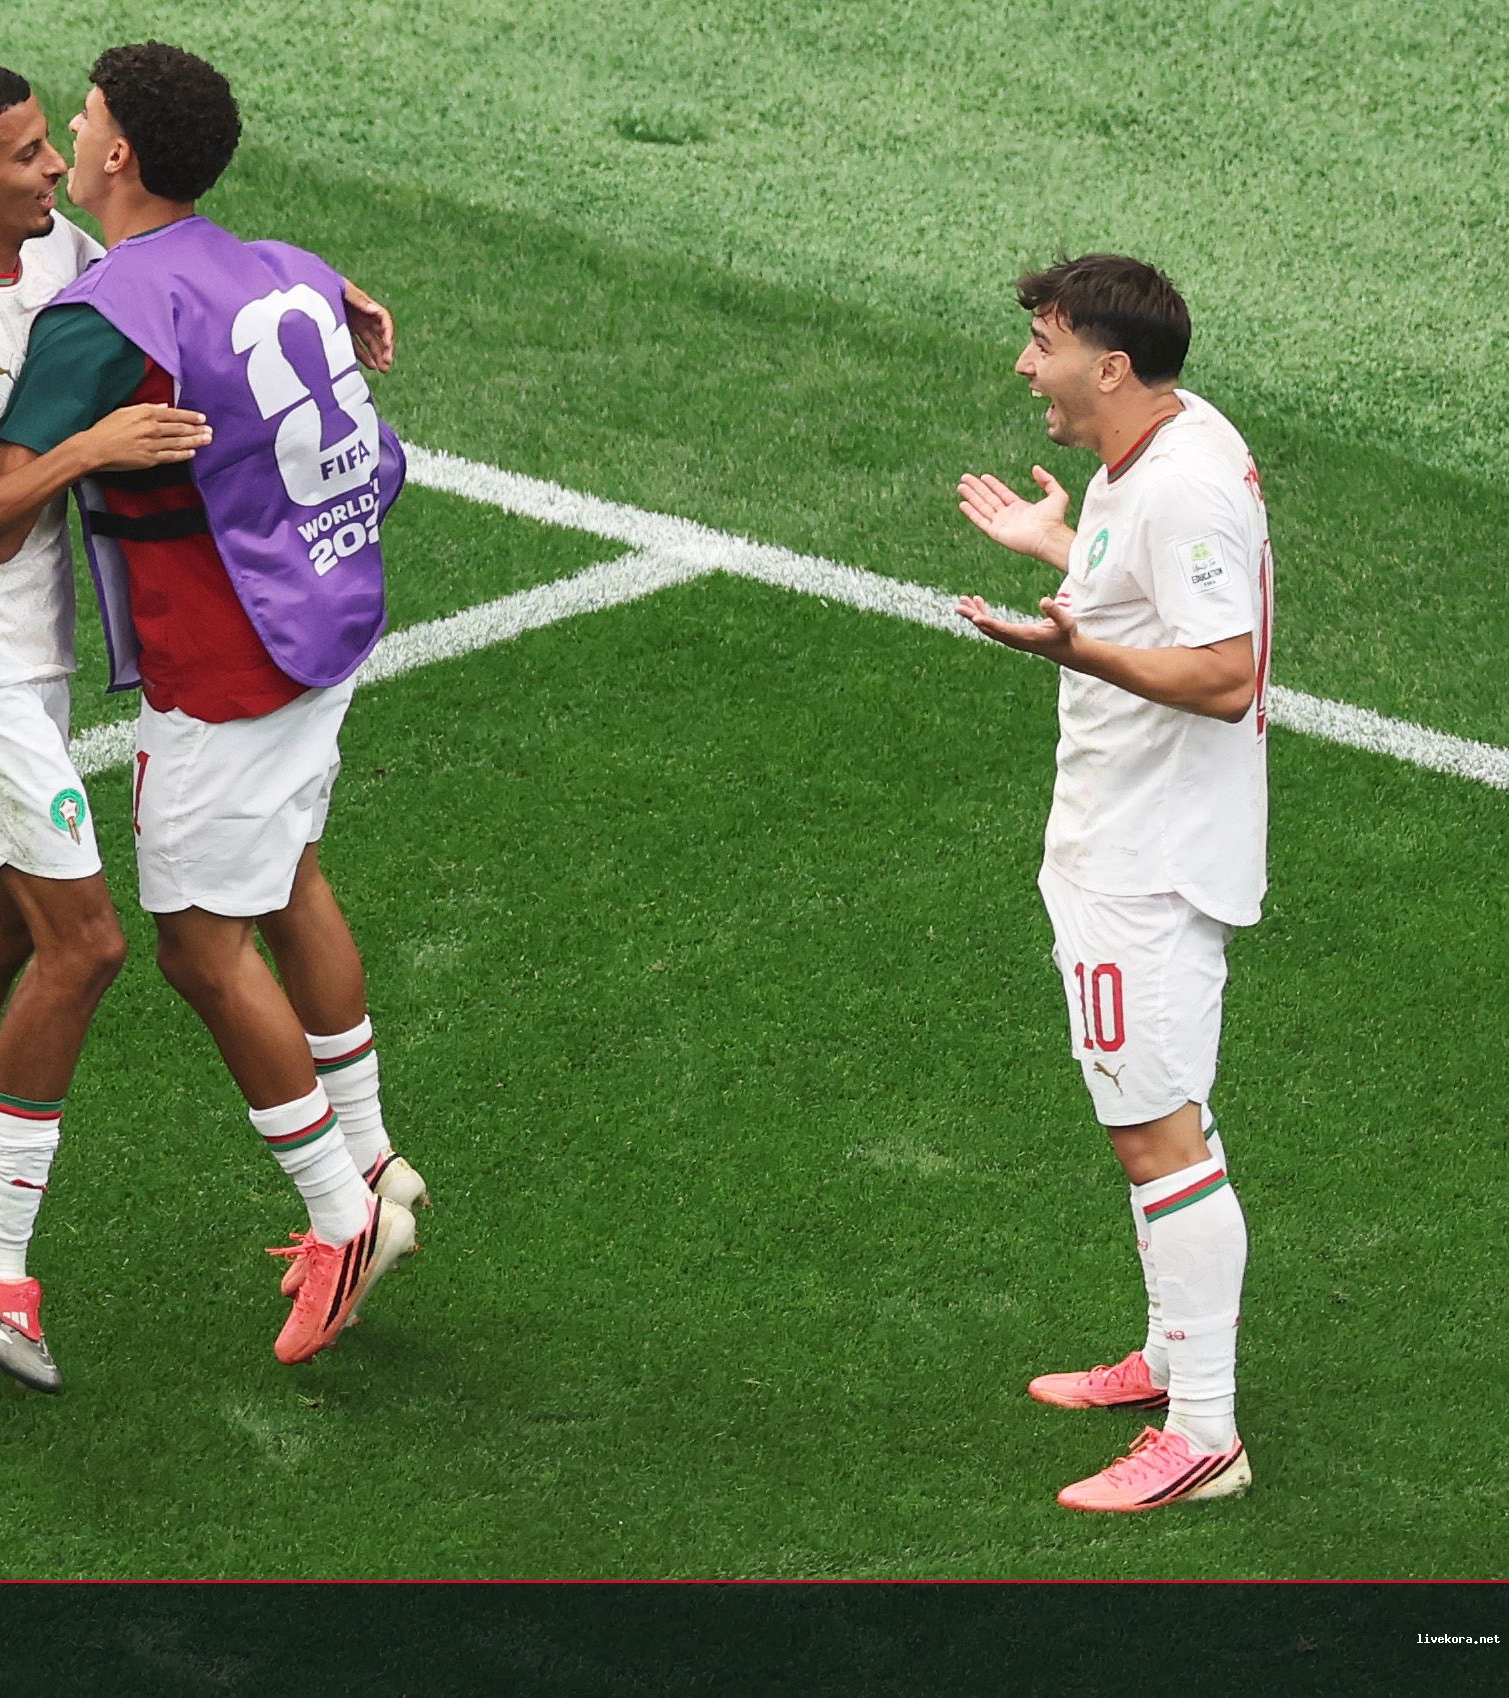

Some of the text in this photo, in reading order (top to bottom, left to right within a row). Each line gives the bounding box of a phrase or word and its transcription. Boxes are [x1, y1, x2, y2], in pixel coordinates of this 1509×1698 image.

[320, 439, 370, 481] FIFA
[297, 493, 374, 543] WORLD
[1074, 962, 1126, 1052] 10
